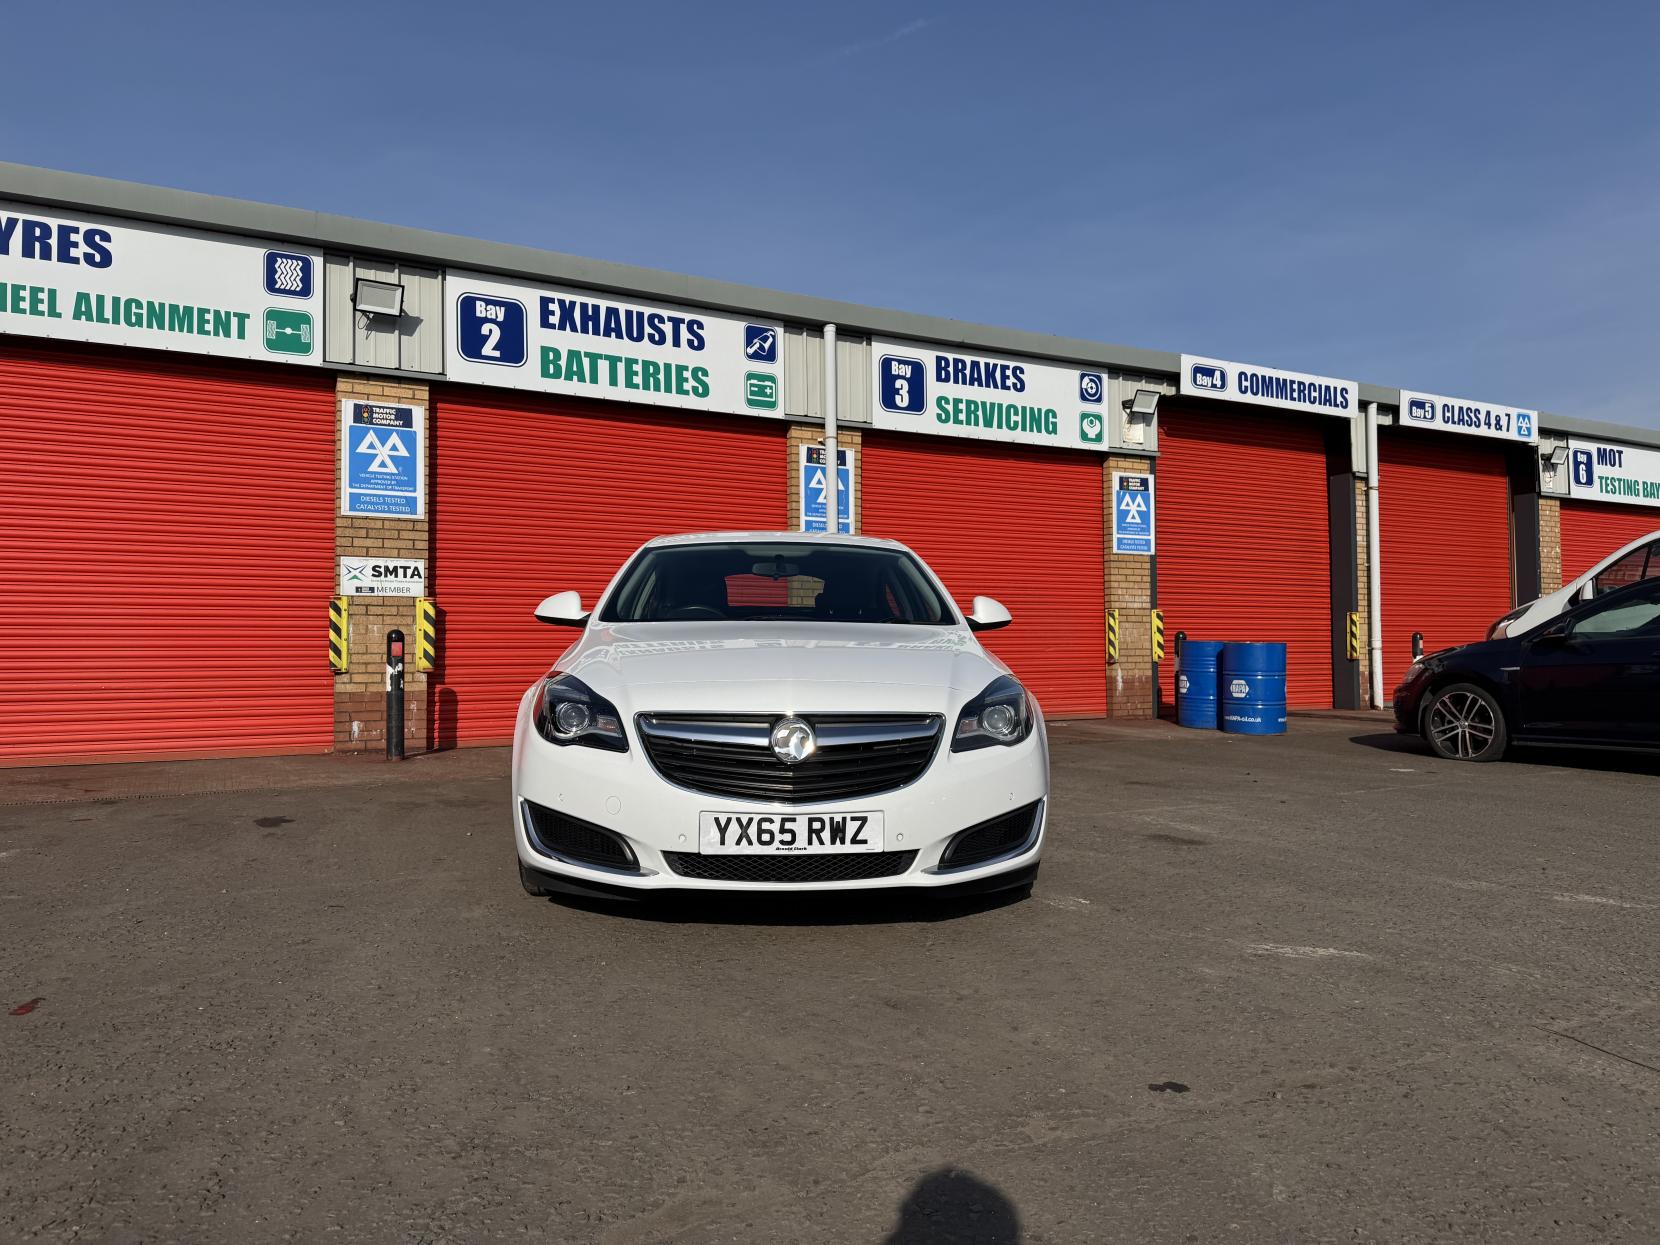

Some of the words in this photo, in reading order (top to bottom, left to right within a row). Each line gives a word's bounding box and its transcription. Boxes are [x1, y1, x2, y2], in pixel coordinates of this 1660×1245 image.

[72, 291, 251, 340] ALIGNMENT
[475, 300, 506, 322] Bay
[539, 295, 706, 351] EXHAUSTS
[480, 322, 502, 358] 2
[539, 345, 710, 399] BATTERIES
[891, 360, 912, 378] Bay
[935, 355, 1026, 393] BRAKES
[1196, 373, 1213, 388] Bay
[1212, 369, 1222, 388] 4
[894, 379, 910, 408] 3
[1237, 371, 1349, 410] COMMERCIALS
[372, 407, 397, 415] TRAFFIC
[372, 418, 404, 426] COMPANY
[935, 395, 1058, 435] SERVICING
[1411, 406, 1425, 419] Bay
[1424, 402, 1432, 420] 5
[1441, 403, 1481, 429] CLASS
[1483, 410, 1492, 430] 4
[1494, 414, 1503, 432] &
[1504, 413, 1511, 433] 7
[1596, 447, 1624, 469] MOT
[1579, 463, 1587, 484] 6
[360, 495, 384, 503] DIESELS
[1598, 475, 1641, 498] TESTING
[1642, 480, 1660, 500] BAY
[371, 565, 423, 579] SMTA
[376, 586, 411, 594] MEMBER
[713, 816, 797, 846] YX65
[807, 816, 868, 846] RWZ
